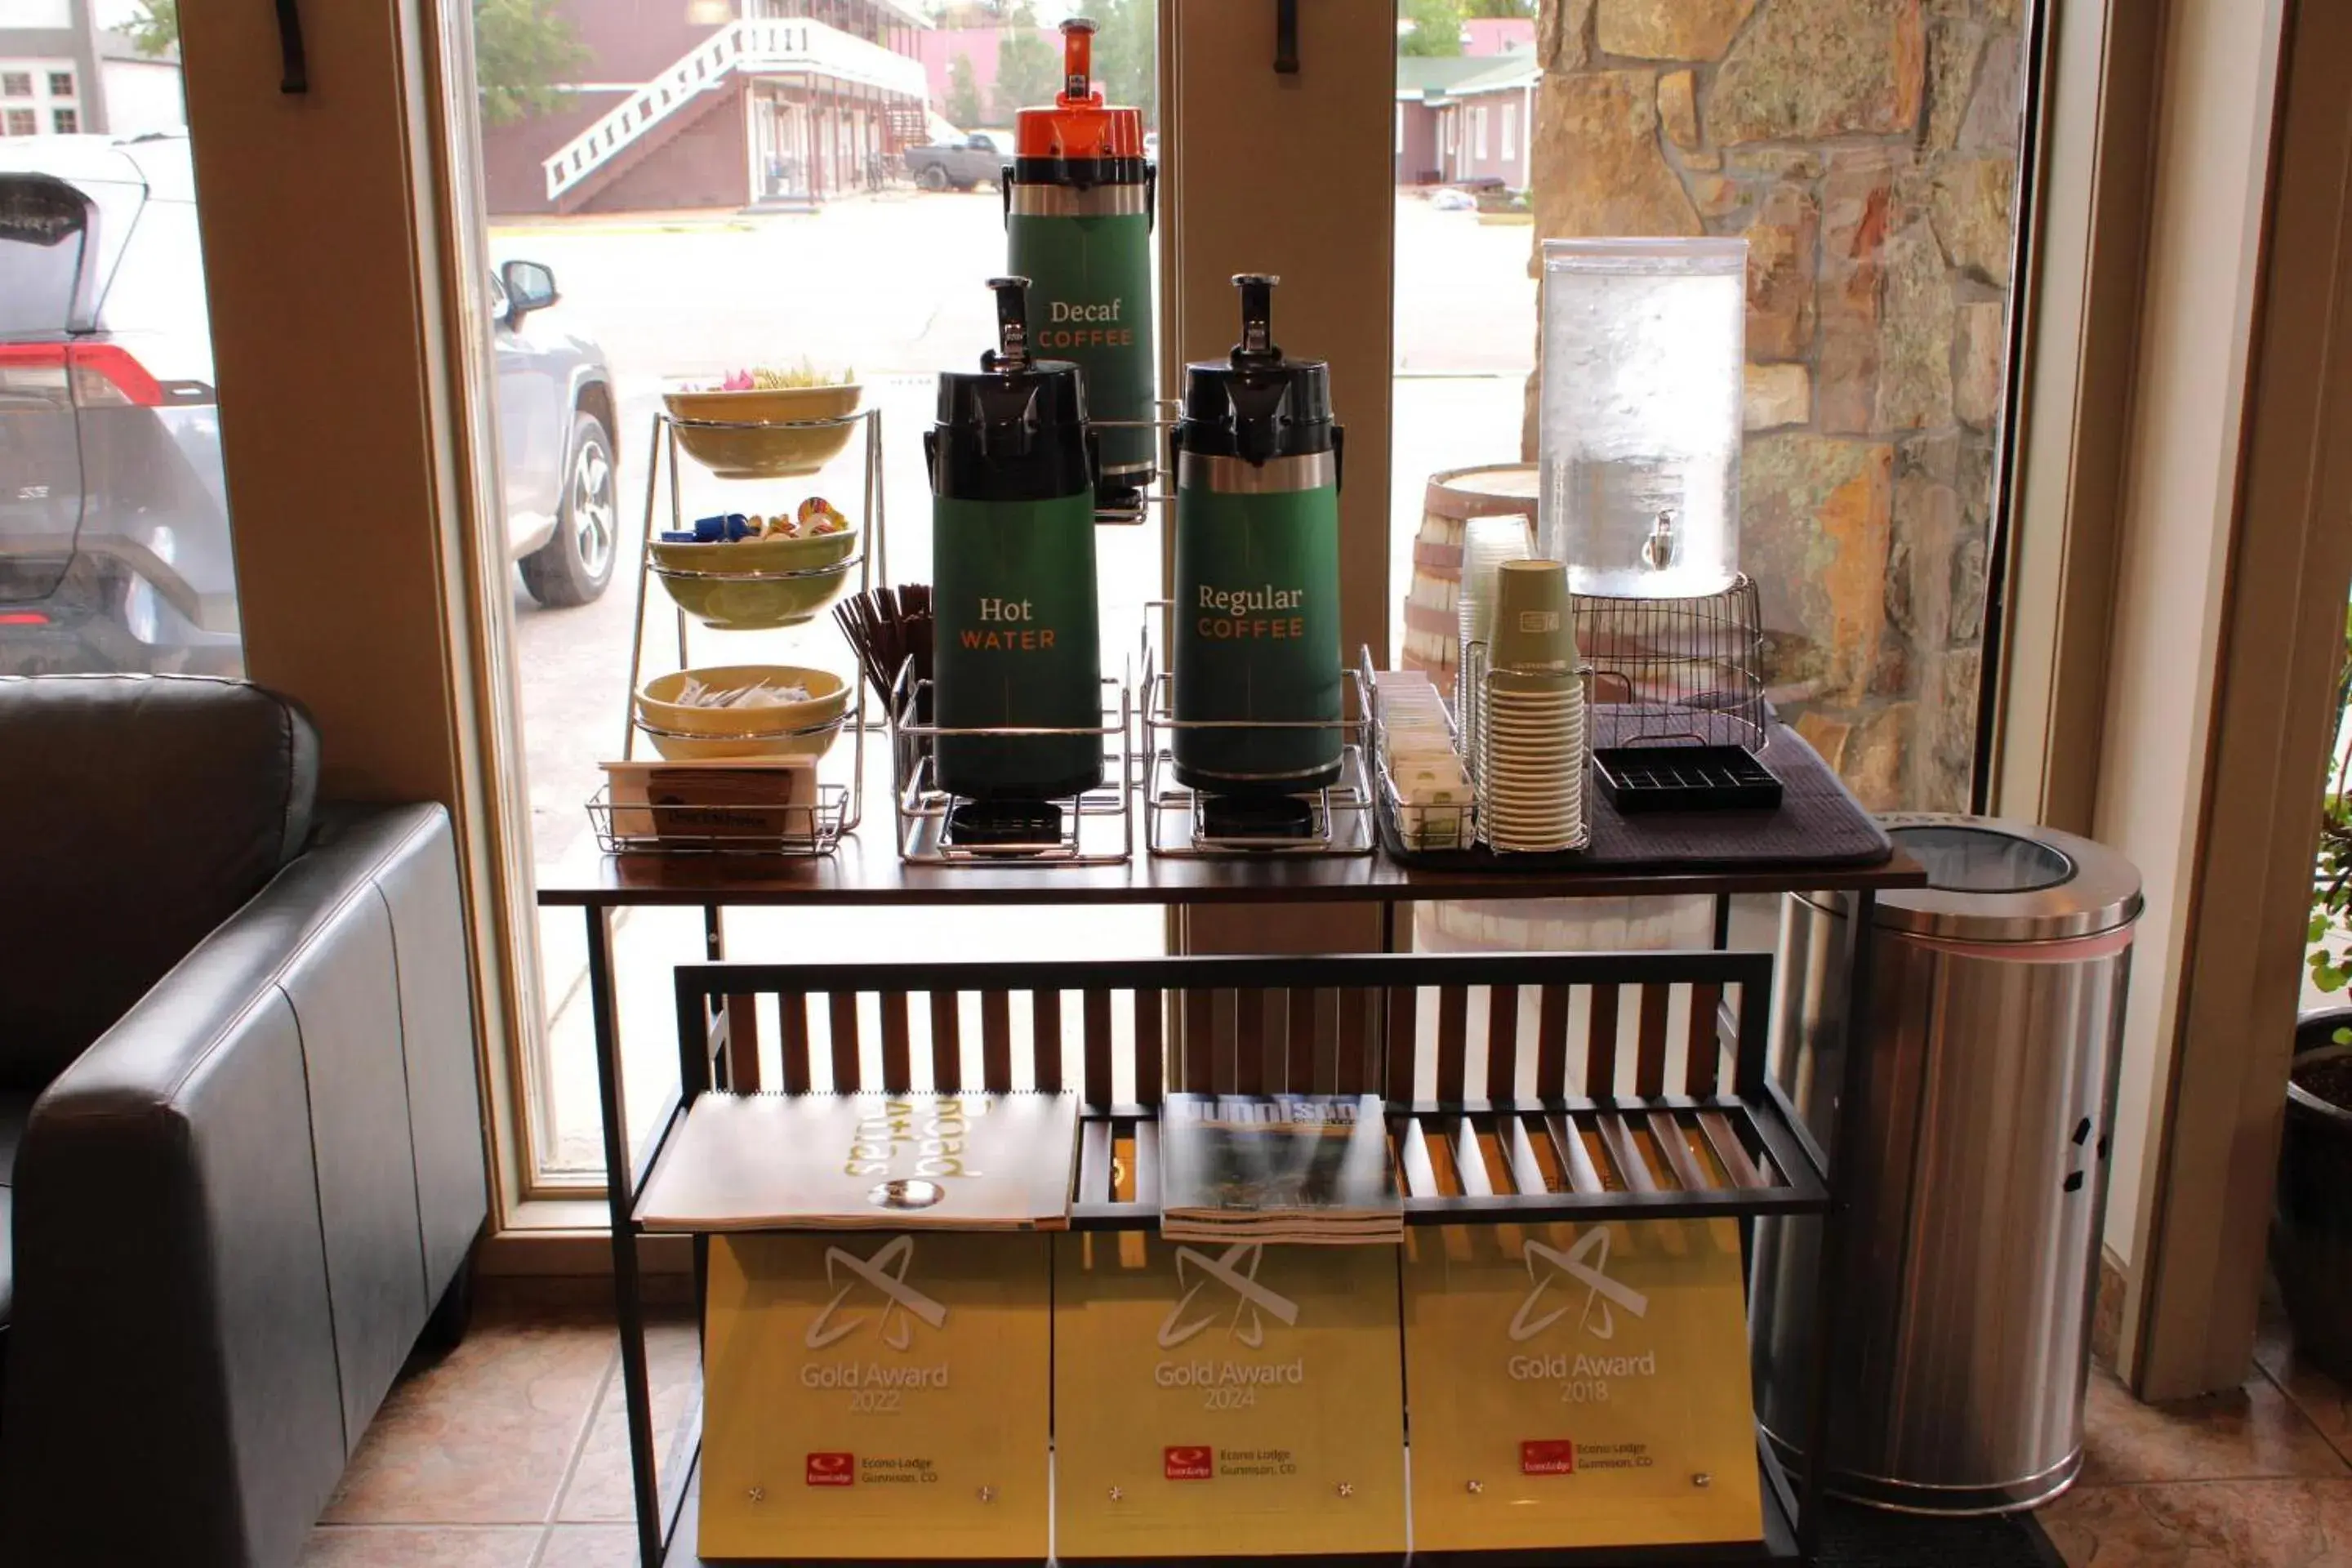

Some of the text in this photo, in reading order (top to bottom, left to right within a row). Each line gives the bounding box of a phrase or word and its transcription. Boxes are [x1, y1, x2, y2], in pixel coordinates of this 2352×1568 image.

[1050, 298, 1121, 322] Decaf
[1039, 328, 1134, 348] COFFEE
[979, 598, 1033, 621] Hot
[1199, 584, 1303, 616] Regular
[1197, 617, 1303, 638] COFFEE
[960, 630, 1056, 650] WATER
[800, 1361, 949, 1388] Gold Award
[1155, 1358, 1303, 1387] Gold Award
[1508, 1351, 1655, 1380] Gold Award
[850, 1389, 901, 1412] 2022
[1205, 1387, 1255, 1410] 2024
[1561, 1379, 1609, 1402] 2018
[862, 1457, 932, 1472] Econo Lodge
[1220, 1449, 1290, 1463] Econo Lodge
[921, 1472, 938, 1483] CO
[1280, 1464, 1297, 1475] CO
